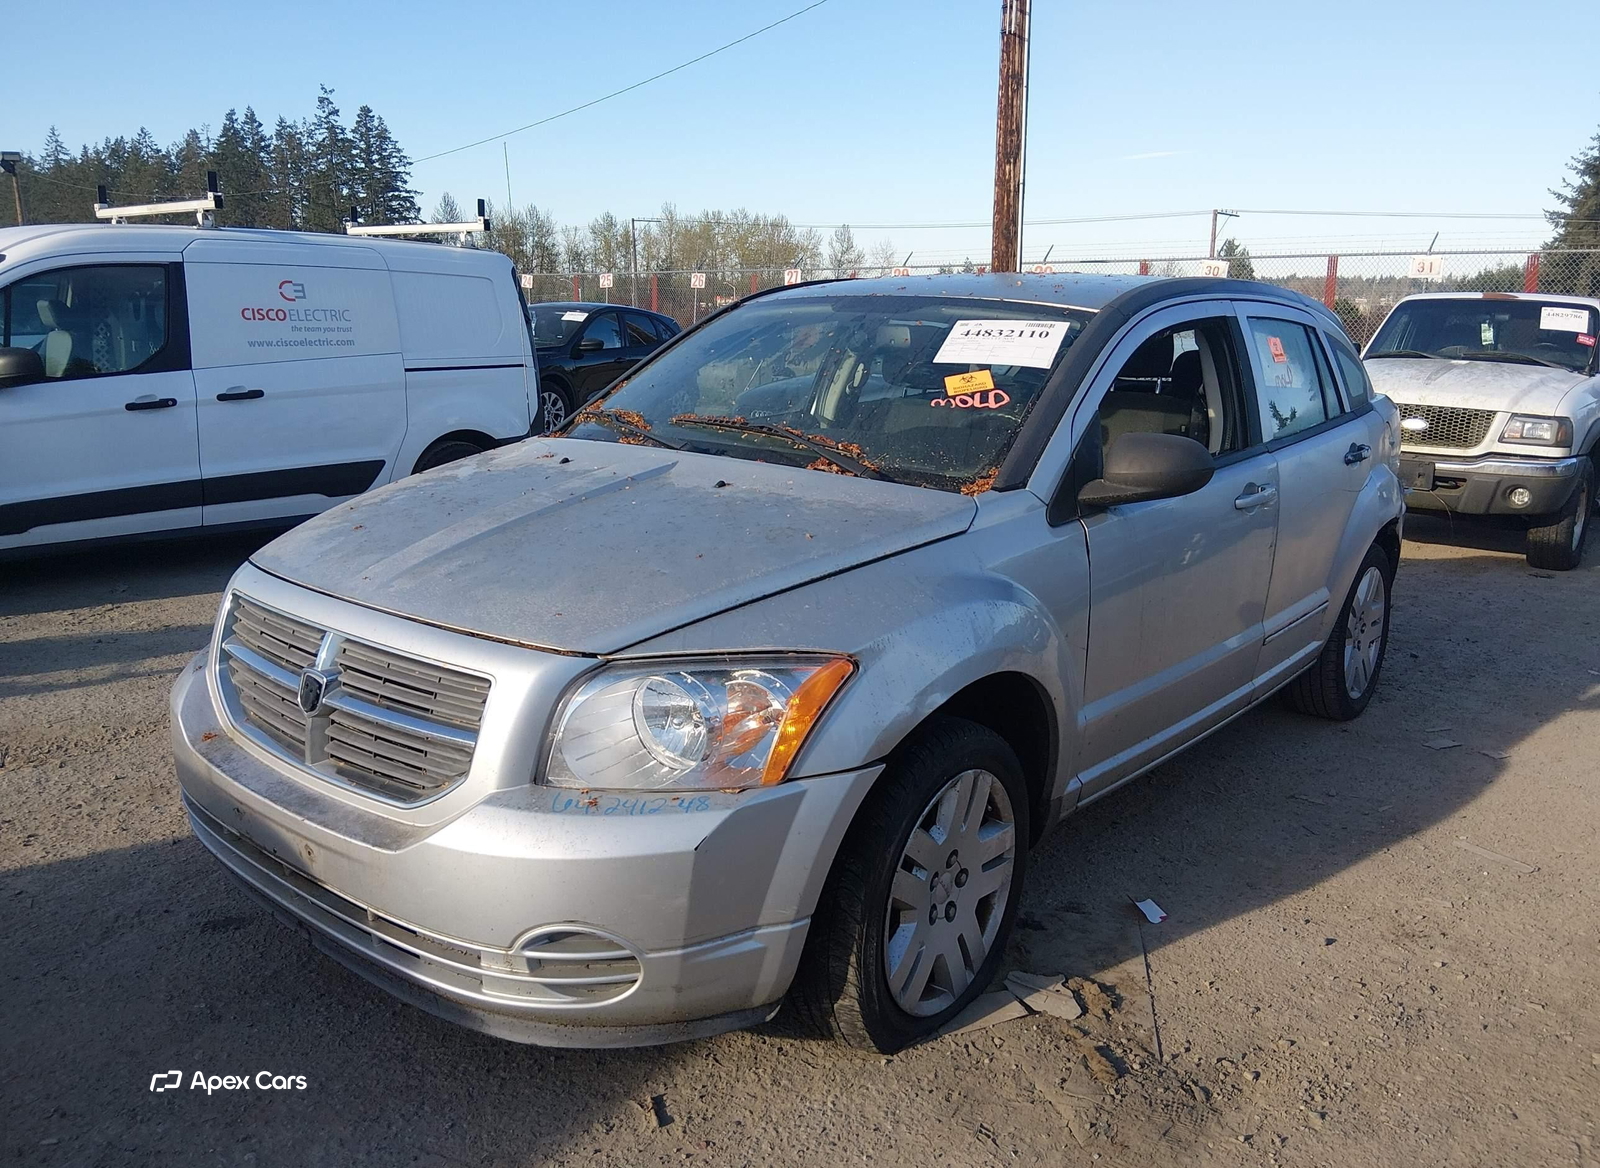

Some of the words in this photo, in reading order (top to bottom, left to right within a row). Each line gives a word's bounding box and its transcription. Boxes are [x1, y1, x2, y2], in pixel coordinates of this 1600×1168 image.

[1204, 265, 1220, 277] 30
[1417, 261, 1433, 273] 31
[522, 275, 532, 288] 24
[601, 274, 611, 287] 25
[692, 274, 704, 287] 26
[786, 270, 799, 285] 27
[291, 325, 303, 333] the
[304, 325, 322, 333] team
[323, 326, 336, 334] you
[960, 328, 1050, 339] 44832110
[247, 338, 355, 347] www.ciscoelectric.com
[952, 381, 987, 391] BIOHAZARD
